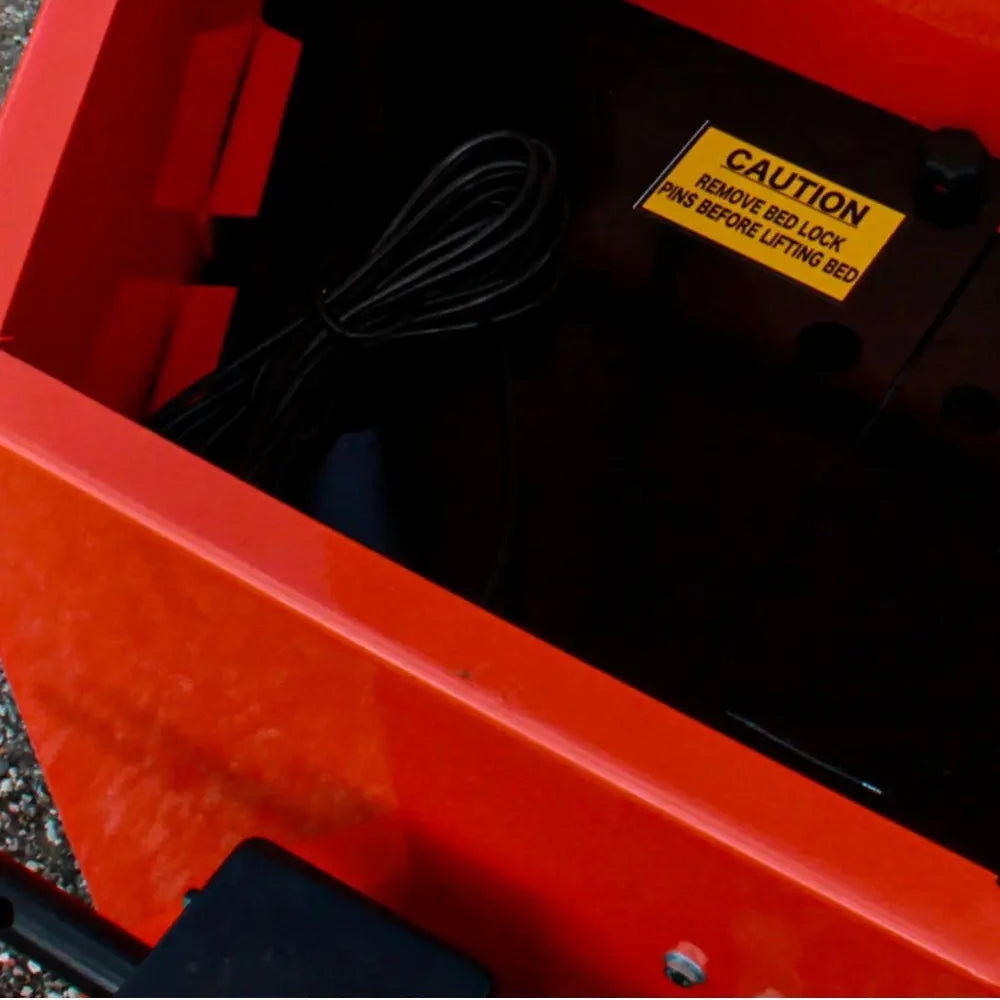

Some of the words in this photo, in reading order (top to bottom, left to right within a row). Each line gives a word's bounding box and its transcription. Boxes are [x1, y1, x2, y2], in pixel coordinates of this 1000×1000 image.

[695, 174, 765, 216] REMOVE
[764, 205, 799, 229] BED
[798, 221, 847, 253] LOCK
[727, 149, 870, 226] CAUTION
[659, 181, 697, 209] PINS
[696, 198, 758, 239] BEFORE
[758, 228, 821, 268] LIFTING
[822, 258, 860, 284] BED
